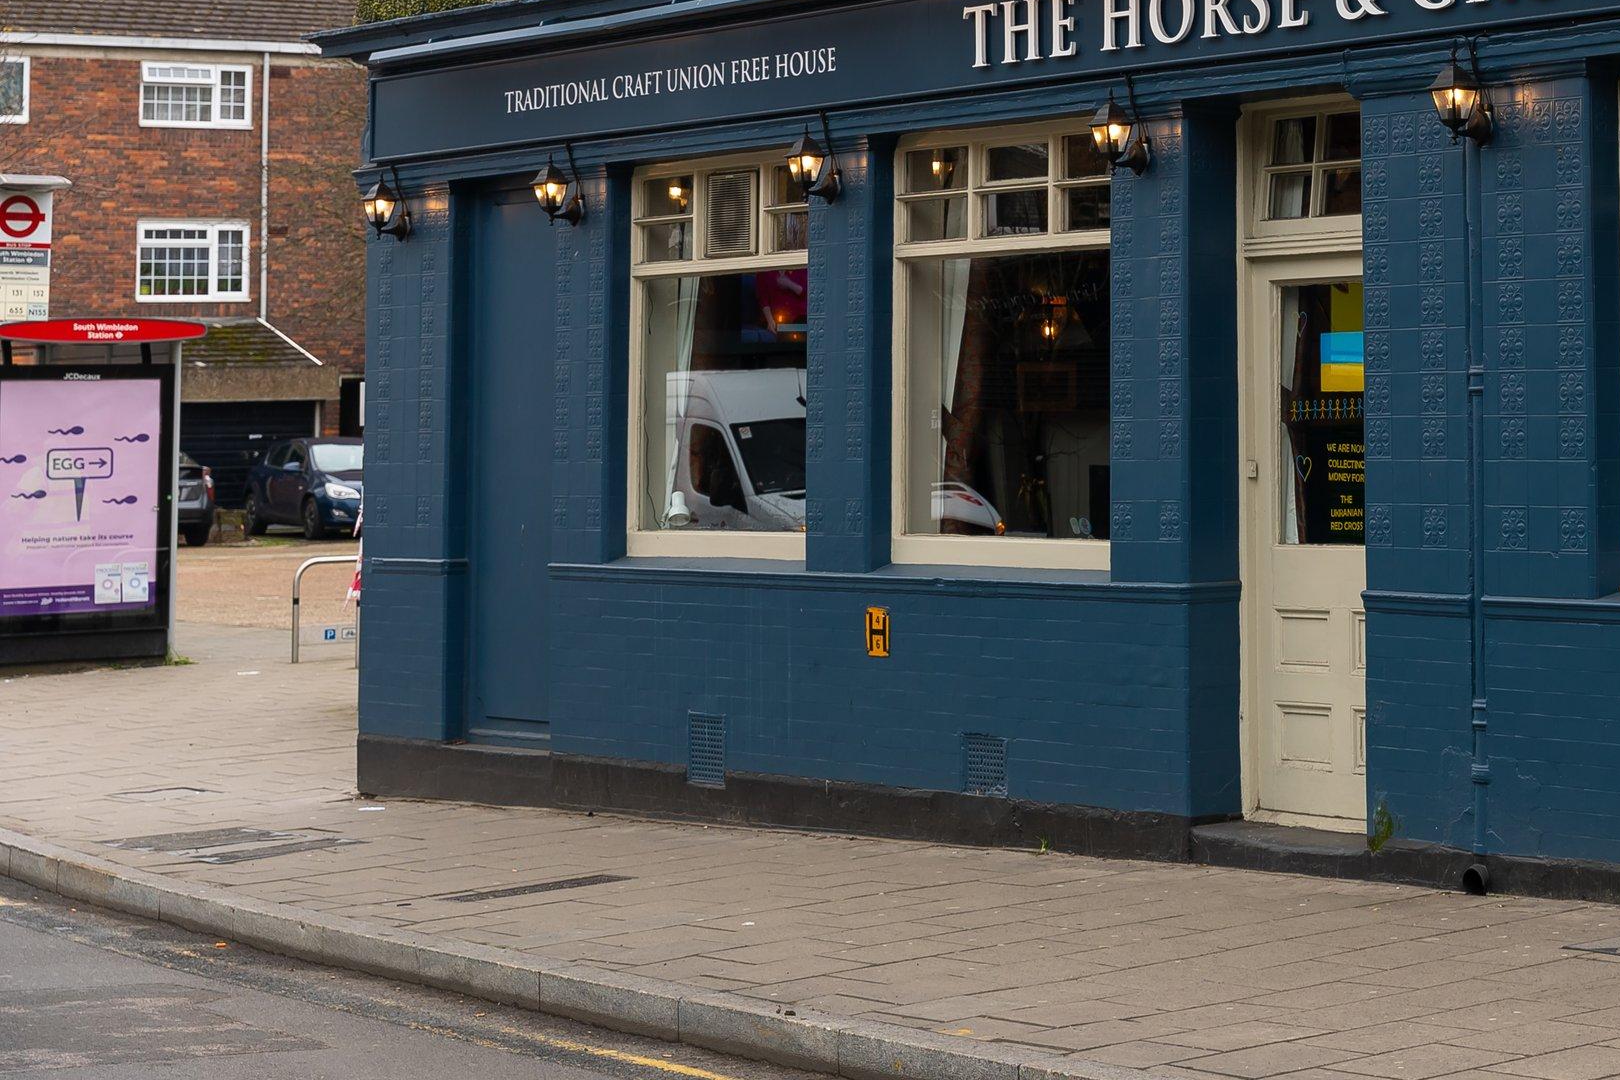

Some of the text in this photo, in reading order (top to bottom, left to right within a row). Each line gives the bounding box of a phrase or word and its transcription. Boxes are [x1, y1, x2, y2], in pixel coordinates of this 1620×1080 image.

[505, 47, 836, 113] TRADITIONAL CRAFT UNION FREE HOUSE
[73, 323, 139, 331] South Wimbledon
[87, 331, 114, 339] Station
[63, 372, 101, 380] JCDecaux
[1327, 444, 1337, 452] WE
[1338, 444, 1350, 452] ARE
[53, 457, 85, 470] EGG
[1328, 473, 1365, 482] MONEY FOR
[1340, 495, 1352, 504] THE
[1331, 522, 1363, 531] RED CROSS
[876, 616, 880, 625] 4
